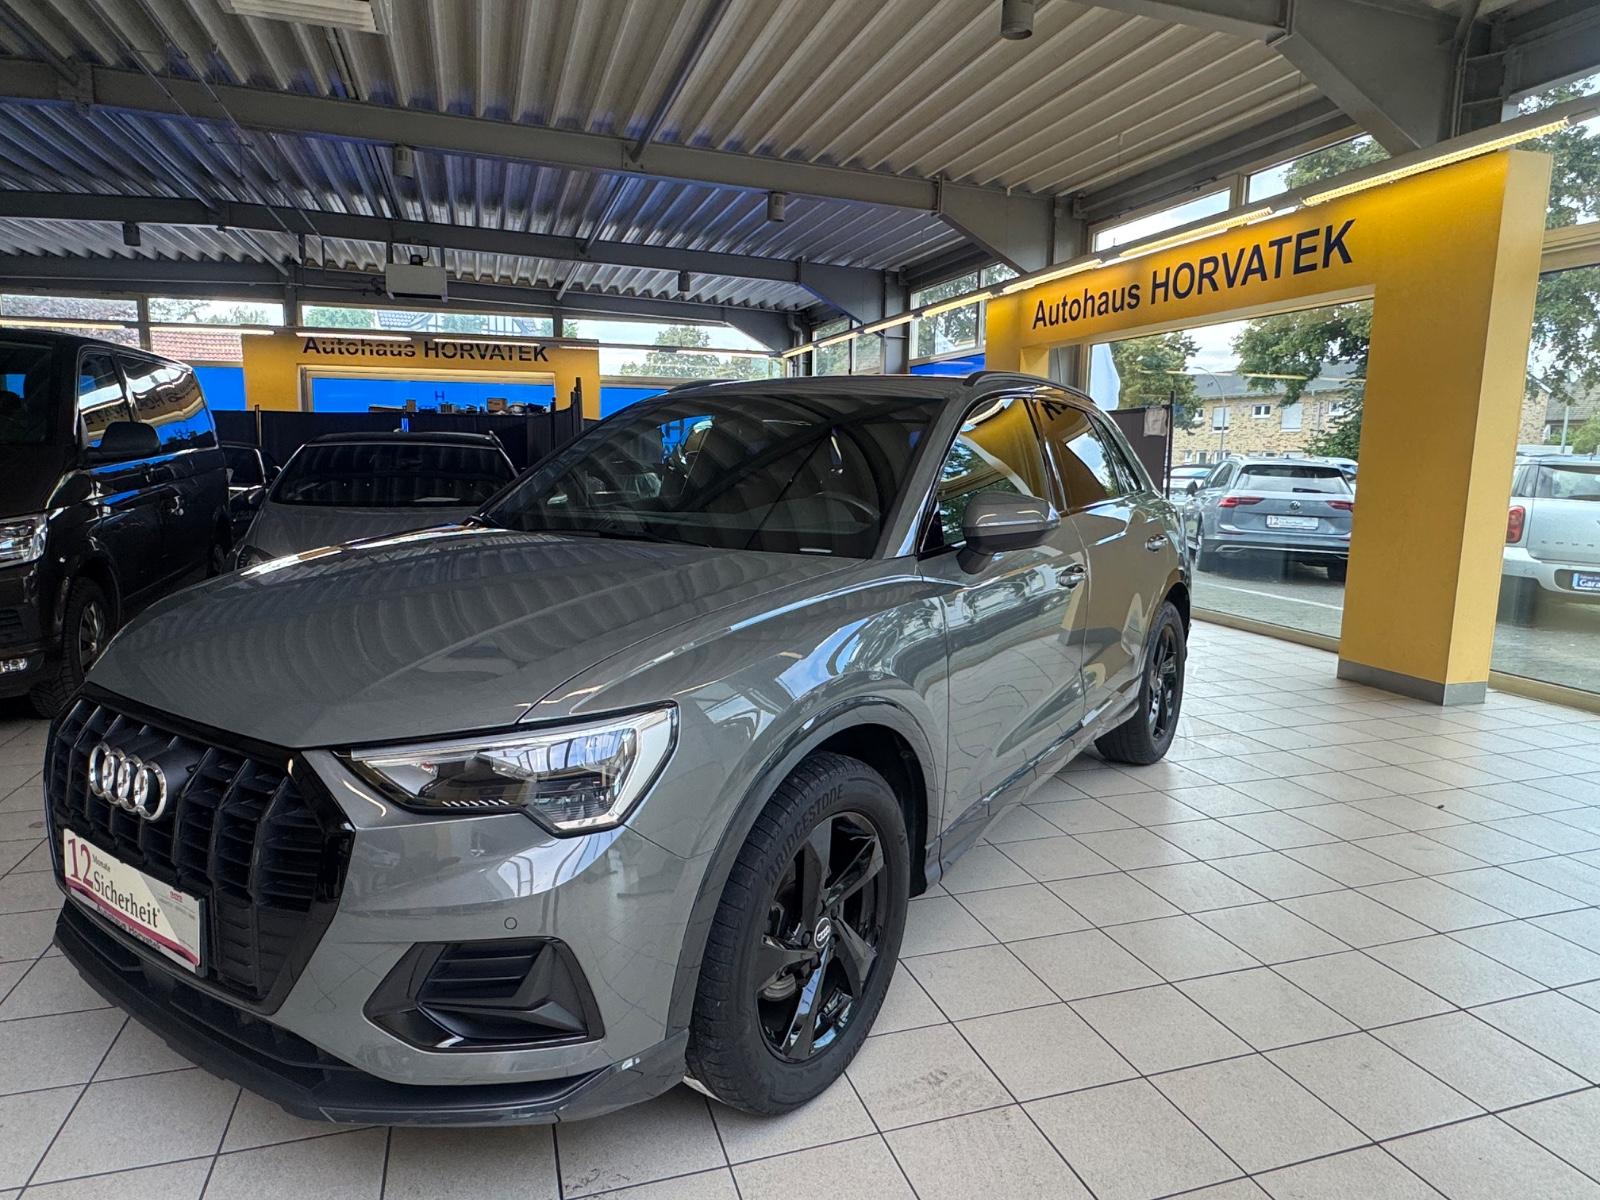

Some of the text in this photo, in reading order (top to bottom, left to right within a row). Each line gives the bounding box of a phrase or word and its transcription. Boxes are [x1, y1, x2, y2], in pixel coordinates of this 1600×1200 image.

[1032, 219, 1356, 330] Autohaus HORVATEK
[303, 336, 549, 362] Autohaus HORVATEK
[67, 837, 94, 889] 12
